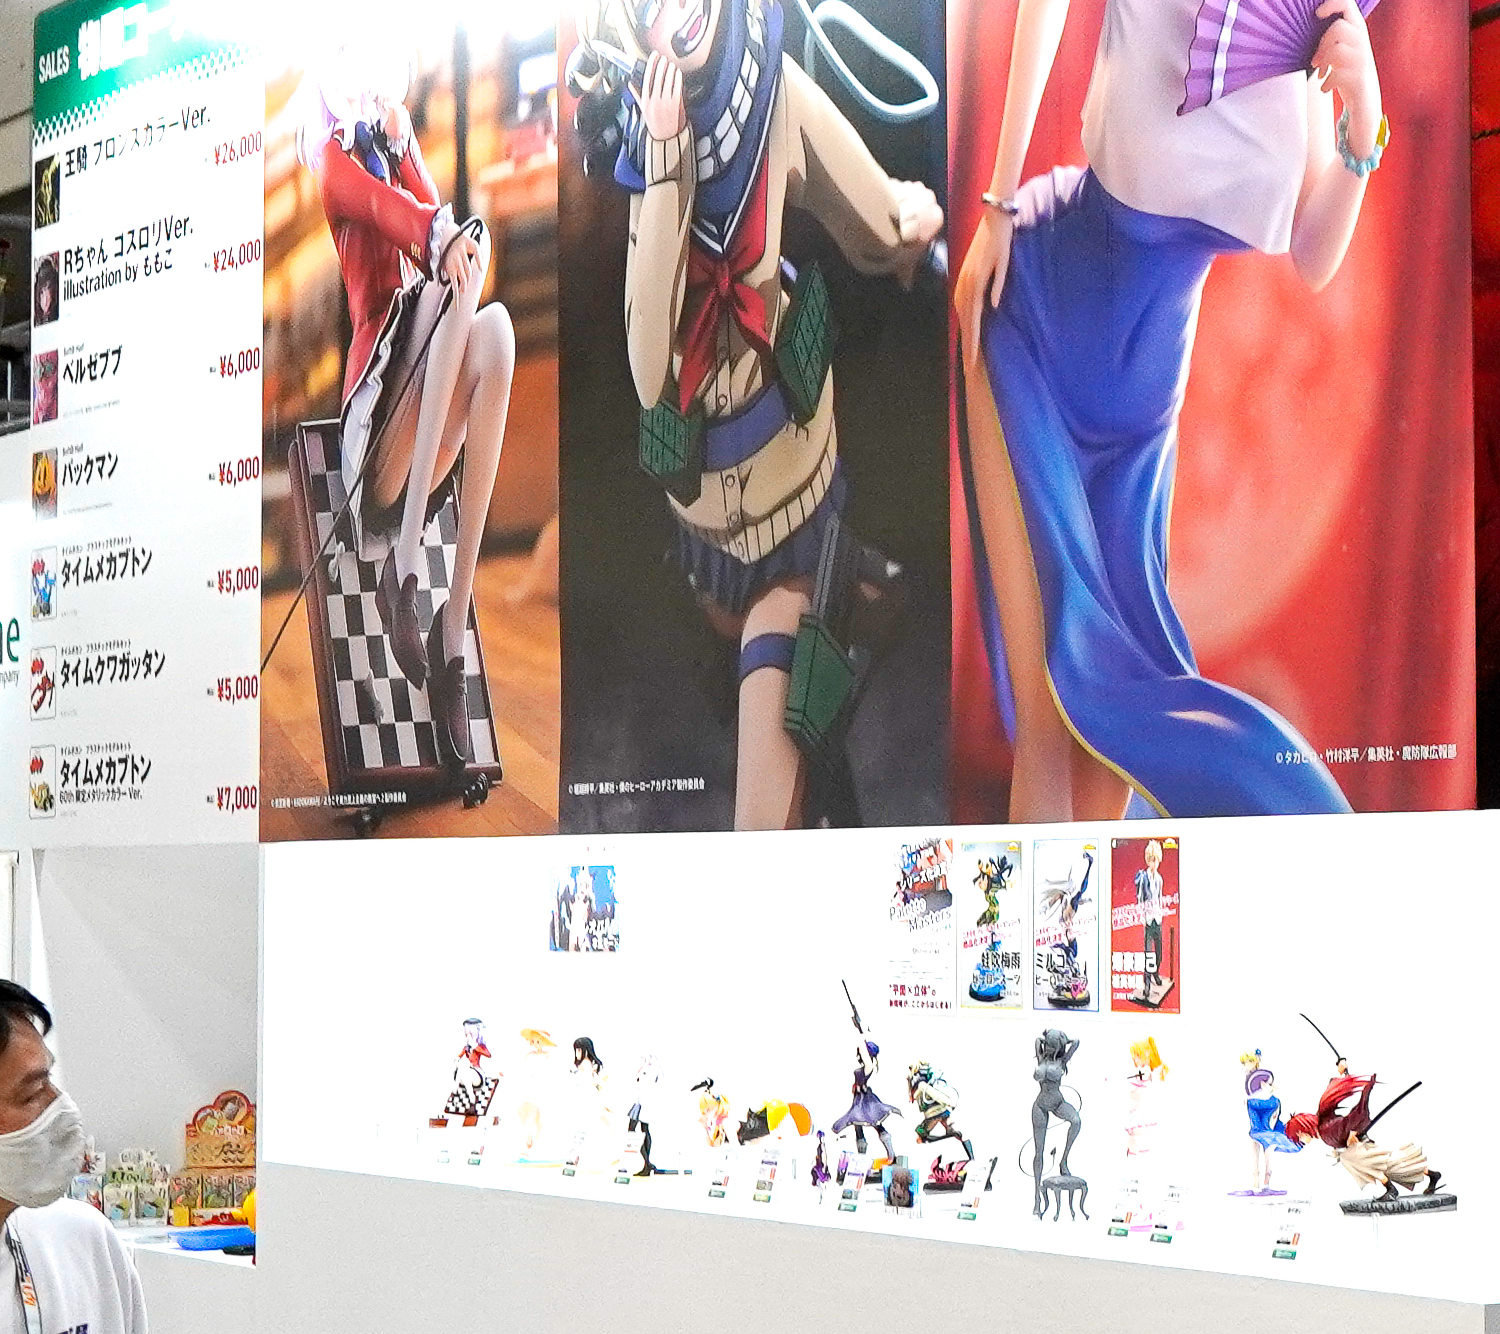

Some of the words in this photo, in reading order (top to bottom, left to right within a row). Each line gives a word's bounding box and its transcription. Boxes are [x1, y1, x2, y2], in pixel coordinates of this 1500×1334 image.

[38, 44, 70, 85] SALES
[214, 130, 263, 168] ¥26,000
[64, 238, 109, 276] Rちゃん
[212, 238, 262, 274] ¥24,000
[62, 266, 123, 303] illustration
[124, 261, 139, 283] by
[62, 344, 124, 386] ベルゼブブ
[219, 346, 261, 380] ¥6,000
[218, 454, 261, 488] ¥6,000
[61, 546, 154, 590] タイムメカブトン
[217, 564, 260, 597] ¥5,000
[60, 648, 166, 690] タイムクワガッタン
[217, 674, 259, 706] ¥5,000
[60, 753, 153, 789] タイムメカブトン
[128, 786, 144, 801] Ver.
[216, 784, 258, 815] ¥7,000
